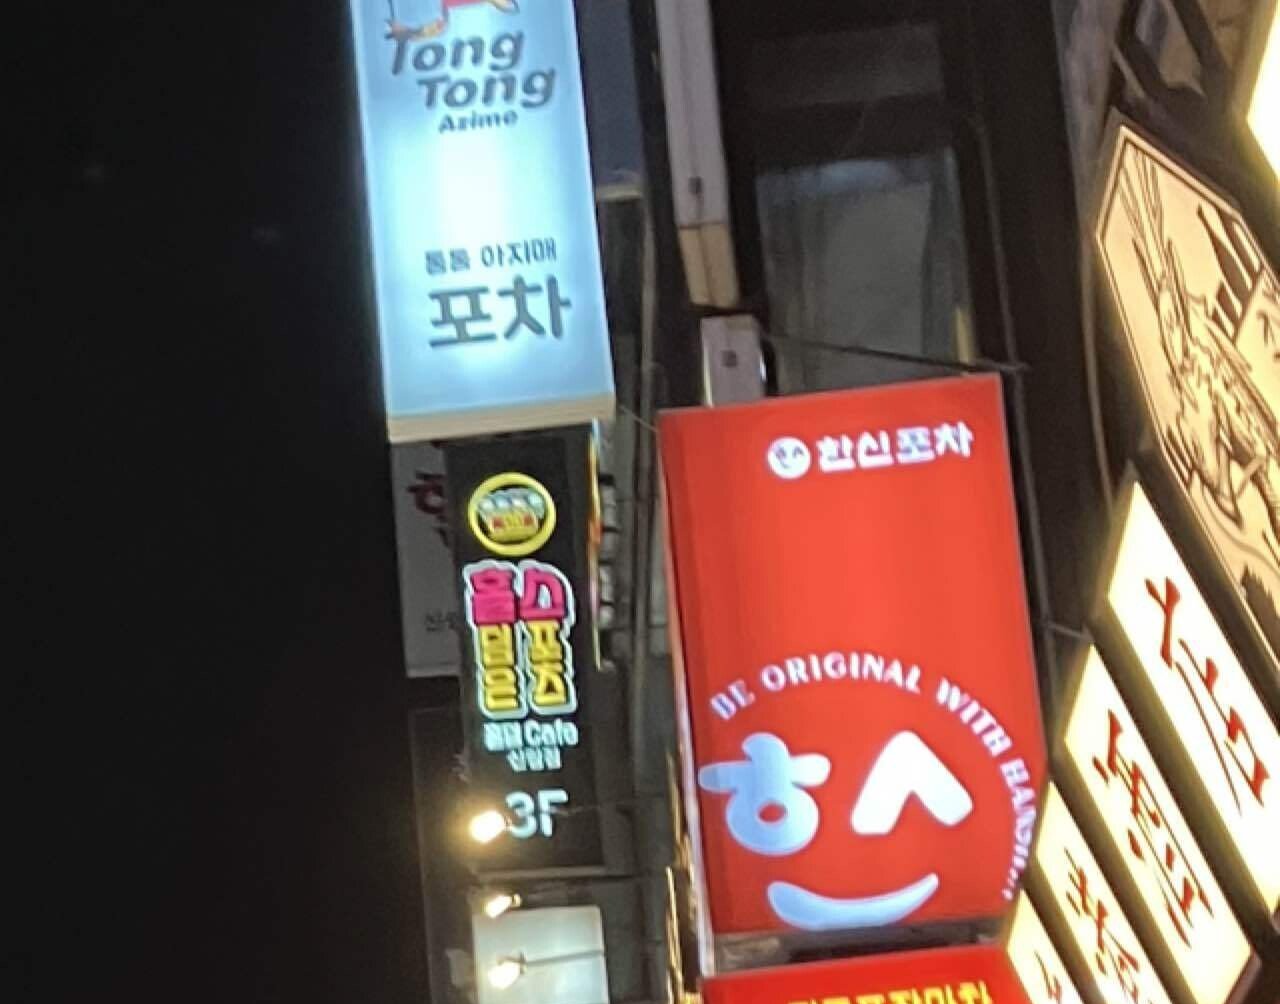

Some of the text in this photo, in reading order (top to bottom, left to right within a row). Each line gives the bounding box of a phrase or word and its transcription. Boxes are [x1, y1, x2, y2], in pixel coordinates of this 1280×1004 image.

[386, 30, 525, 74] Tong
[418, 69, 557, 110] Tong
[481, 238, 559, 270] 아지매
[428, 275, 572, 347] 포차
[817, 422, 975, 473] 한신포차
[709, 679, 755, 721] BE
[759, 650, 924, 694] ORIGINAL
[935, 677, 1014, 756] WITH
[505, 788, 569, 840] 3F
